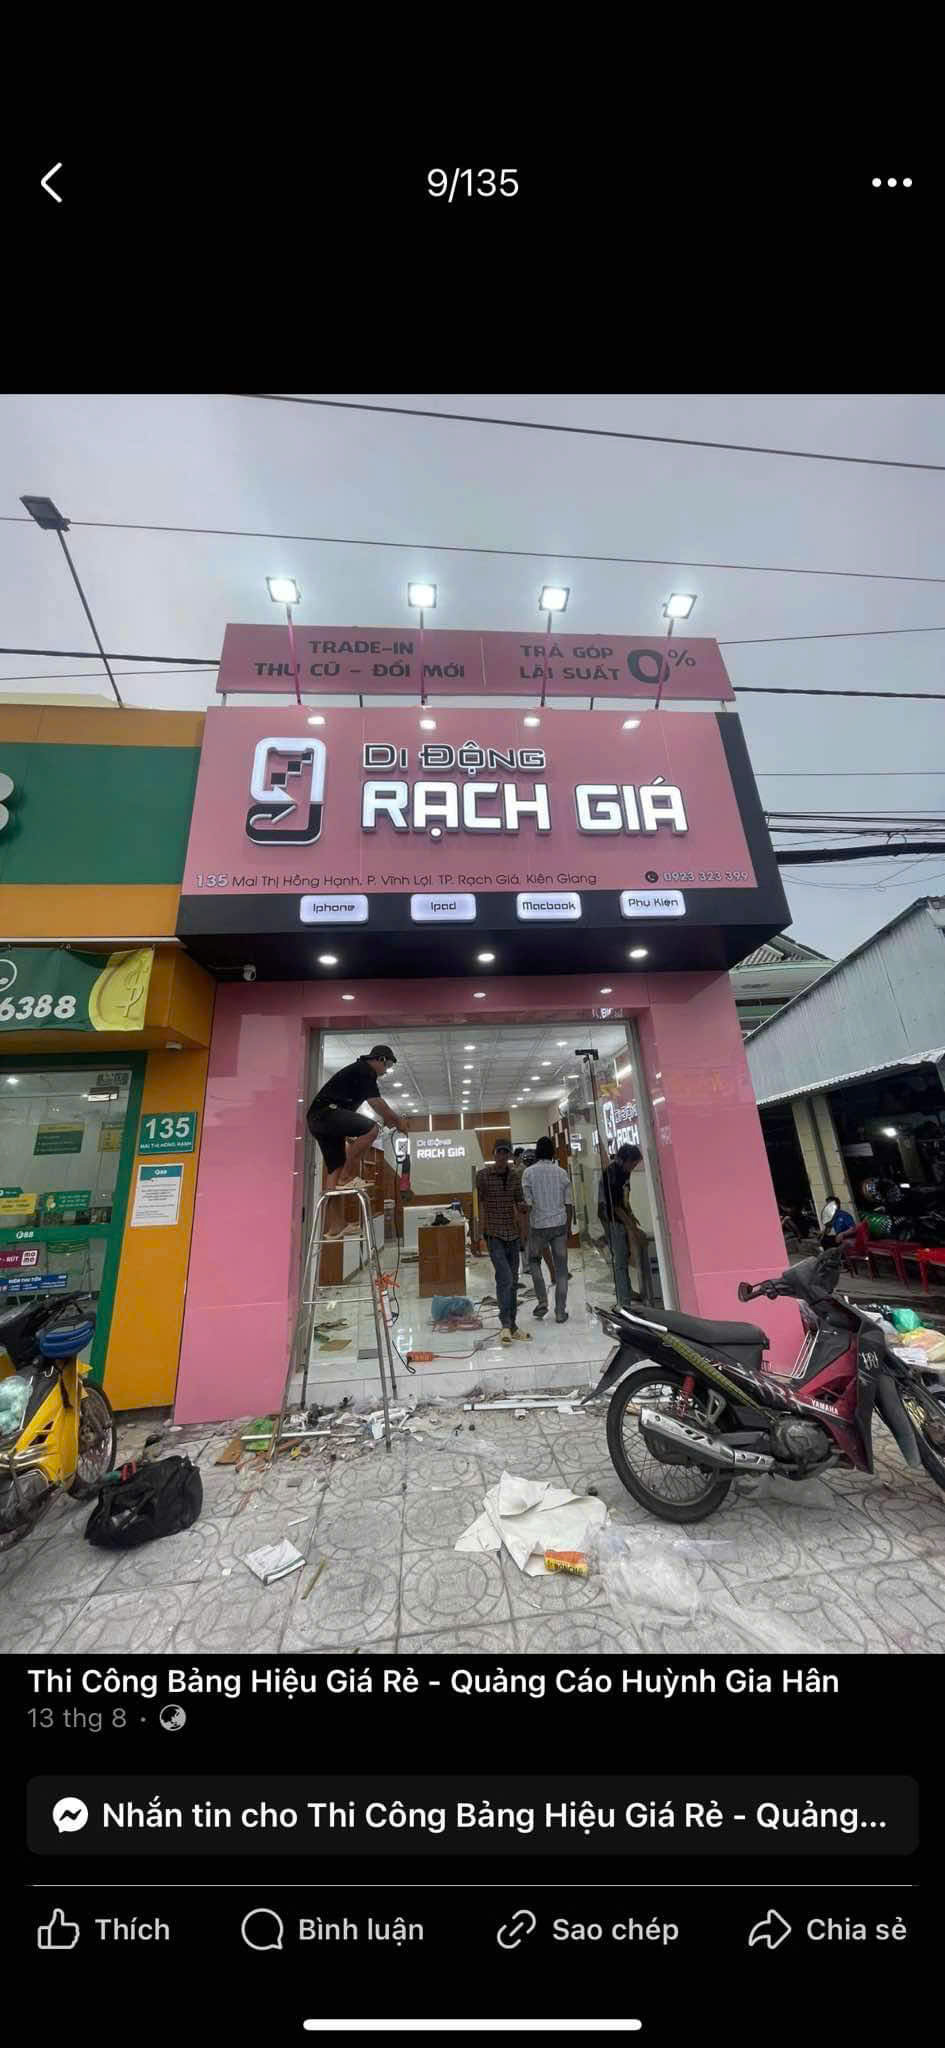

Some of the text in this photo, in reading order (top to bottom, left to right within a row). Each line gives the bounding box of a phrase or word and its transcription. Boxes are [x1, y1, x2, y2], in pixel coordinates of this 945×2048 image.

[309, 640, 414, 655] TRADE-IN
[520, 641, 613, 659] TRẢ GÓP
[254, 662, 299, 678] THU
[309, 660, 340, 677] CŨ
[372, 659, 410, 678] ĐỔI
[422, 661, 464, 679] MỚI
[520, 663, 620, 681] LÃI SUẤT
[419, 740, 546, 777] ĐỘNG
[361, 776, 689, 839] RẠCH GIÁ
[195, 873, 229, 888] 135
[232, 875, 257, 887] Mai
[262, 874, 279, 889] Thị
[283, 873, 320, 889] Hồng
[382, 873, 409, 886] Vĩnh
[458, 873, 492, 887] Rạch
[526, 873, 553, 885] Kiên
[557, 873, 597, 886] Giang
[663, 870, 695, 882] 0923
[699, 870, 722, 882] 323
[522, 901, 576, 911] Macbook
[145, 1117, 190, 1139] 135
[811, 1399, 839, 1416] YAMAHA
